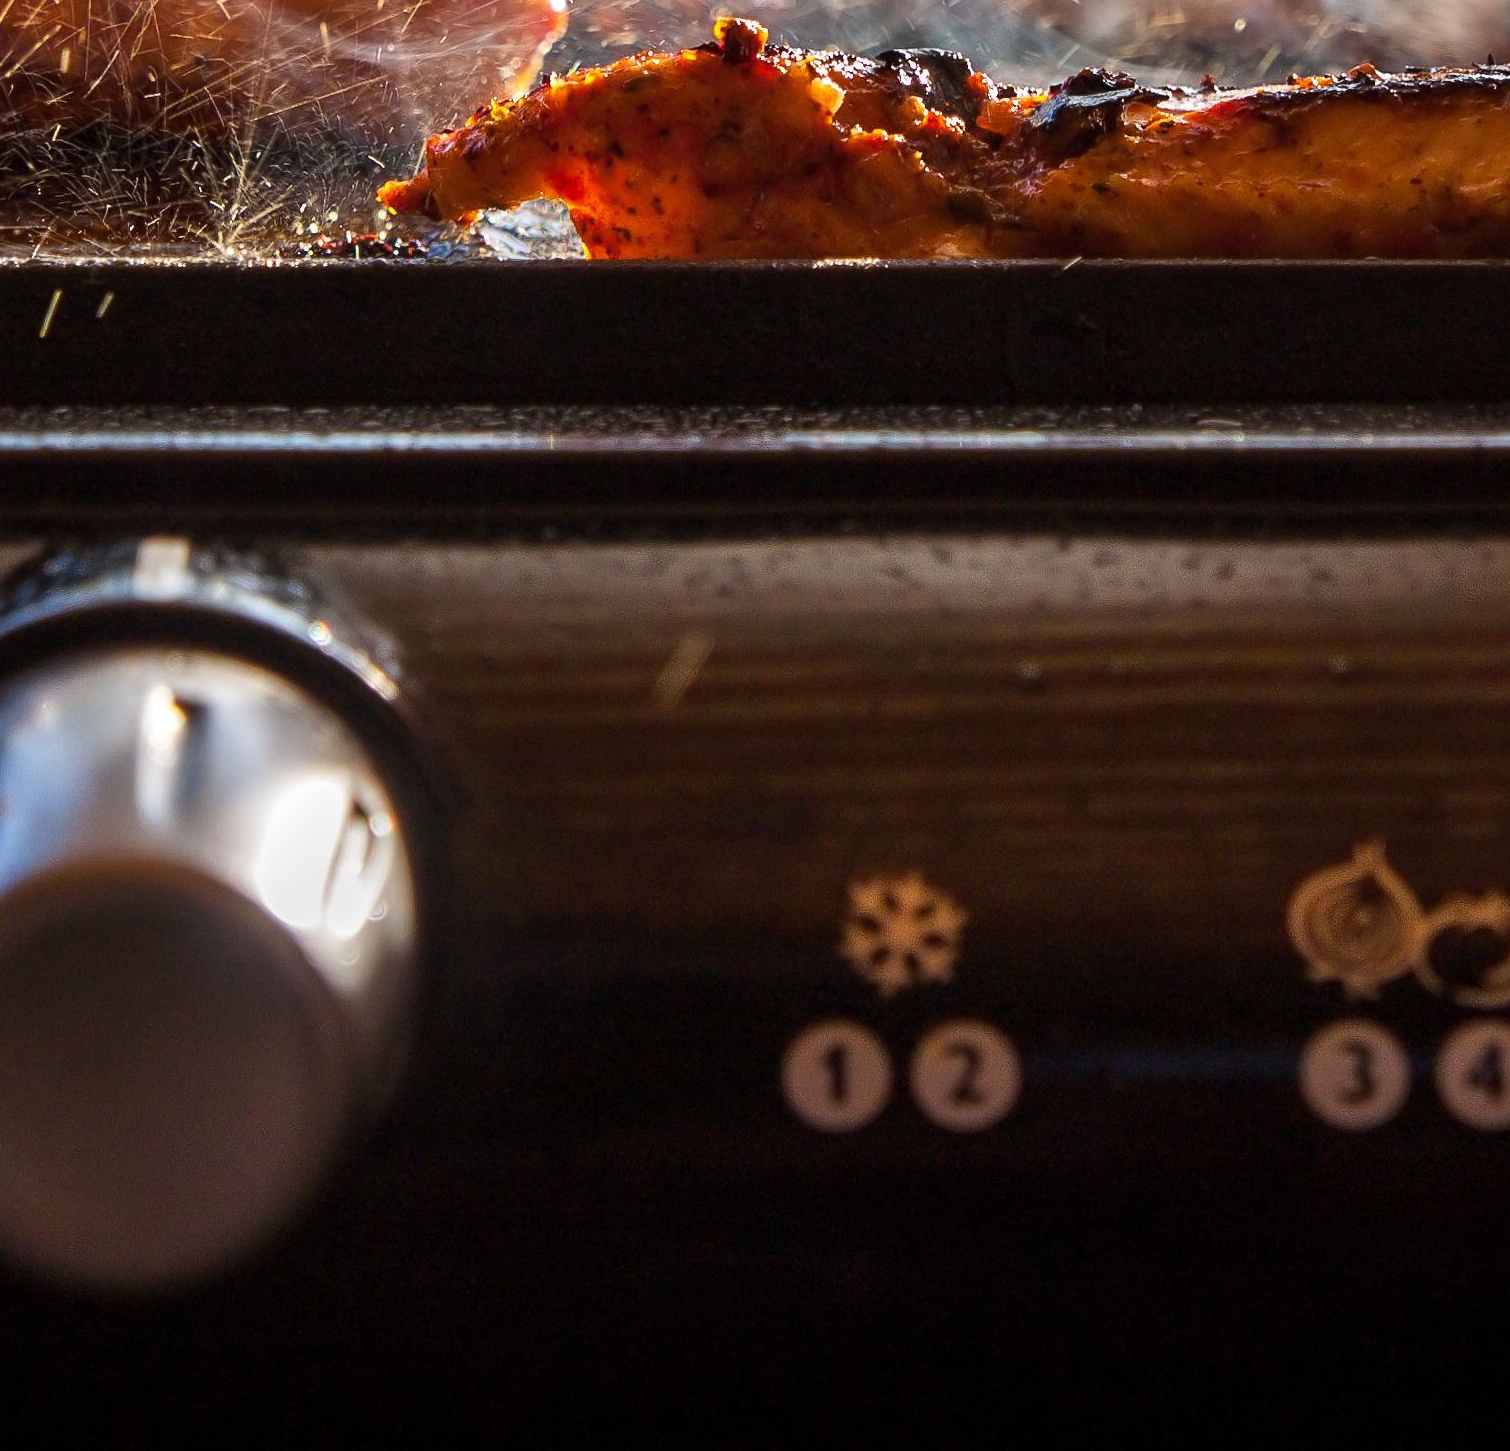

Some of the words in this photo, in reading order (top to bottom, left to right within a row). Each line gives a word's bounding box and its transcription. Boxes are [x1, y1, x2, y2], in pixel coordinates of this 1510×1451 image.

[821, 1044, 849, 1104] 1
[947, 1043, 984, 1106] 2
[1339, 1041, 1378, 1107] 3
[1467, 1045, 1507, 1104] 4
